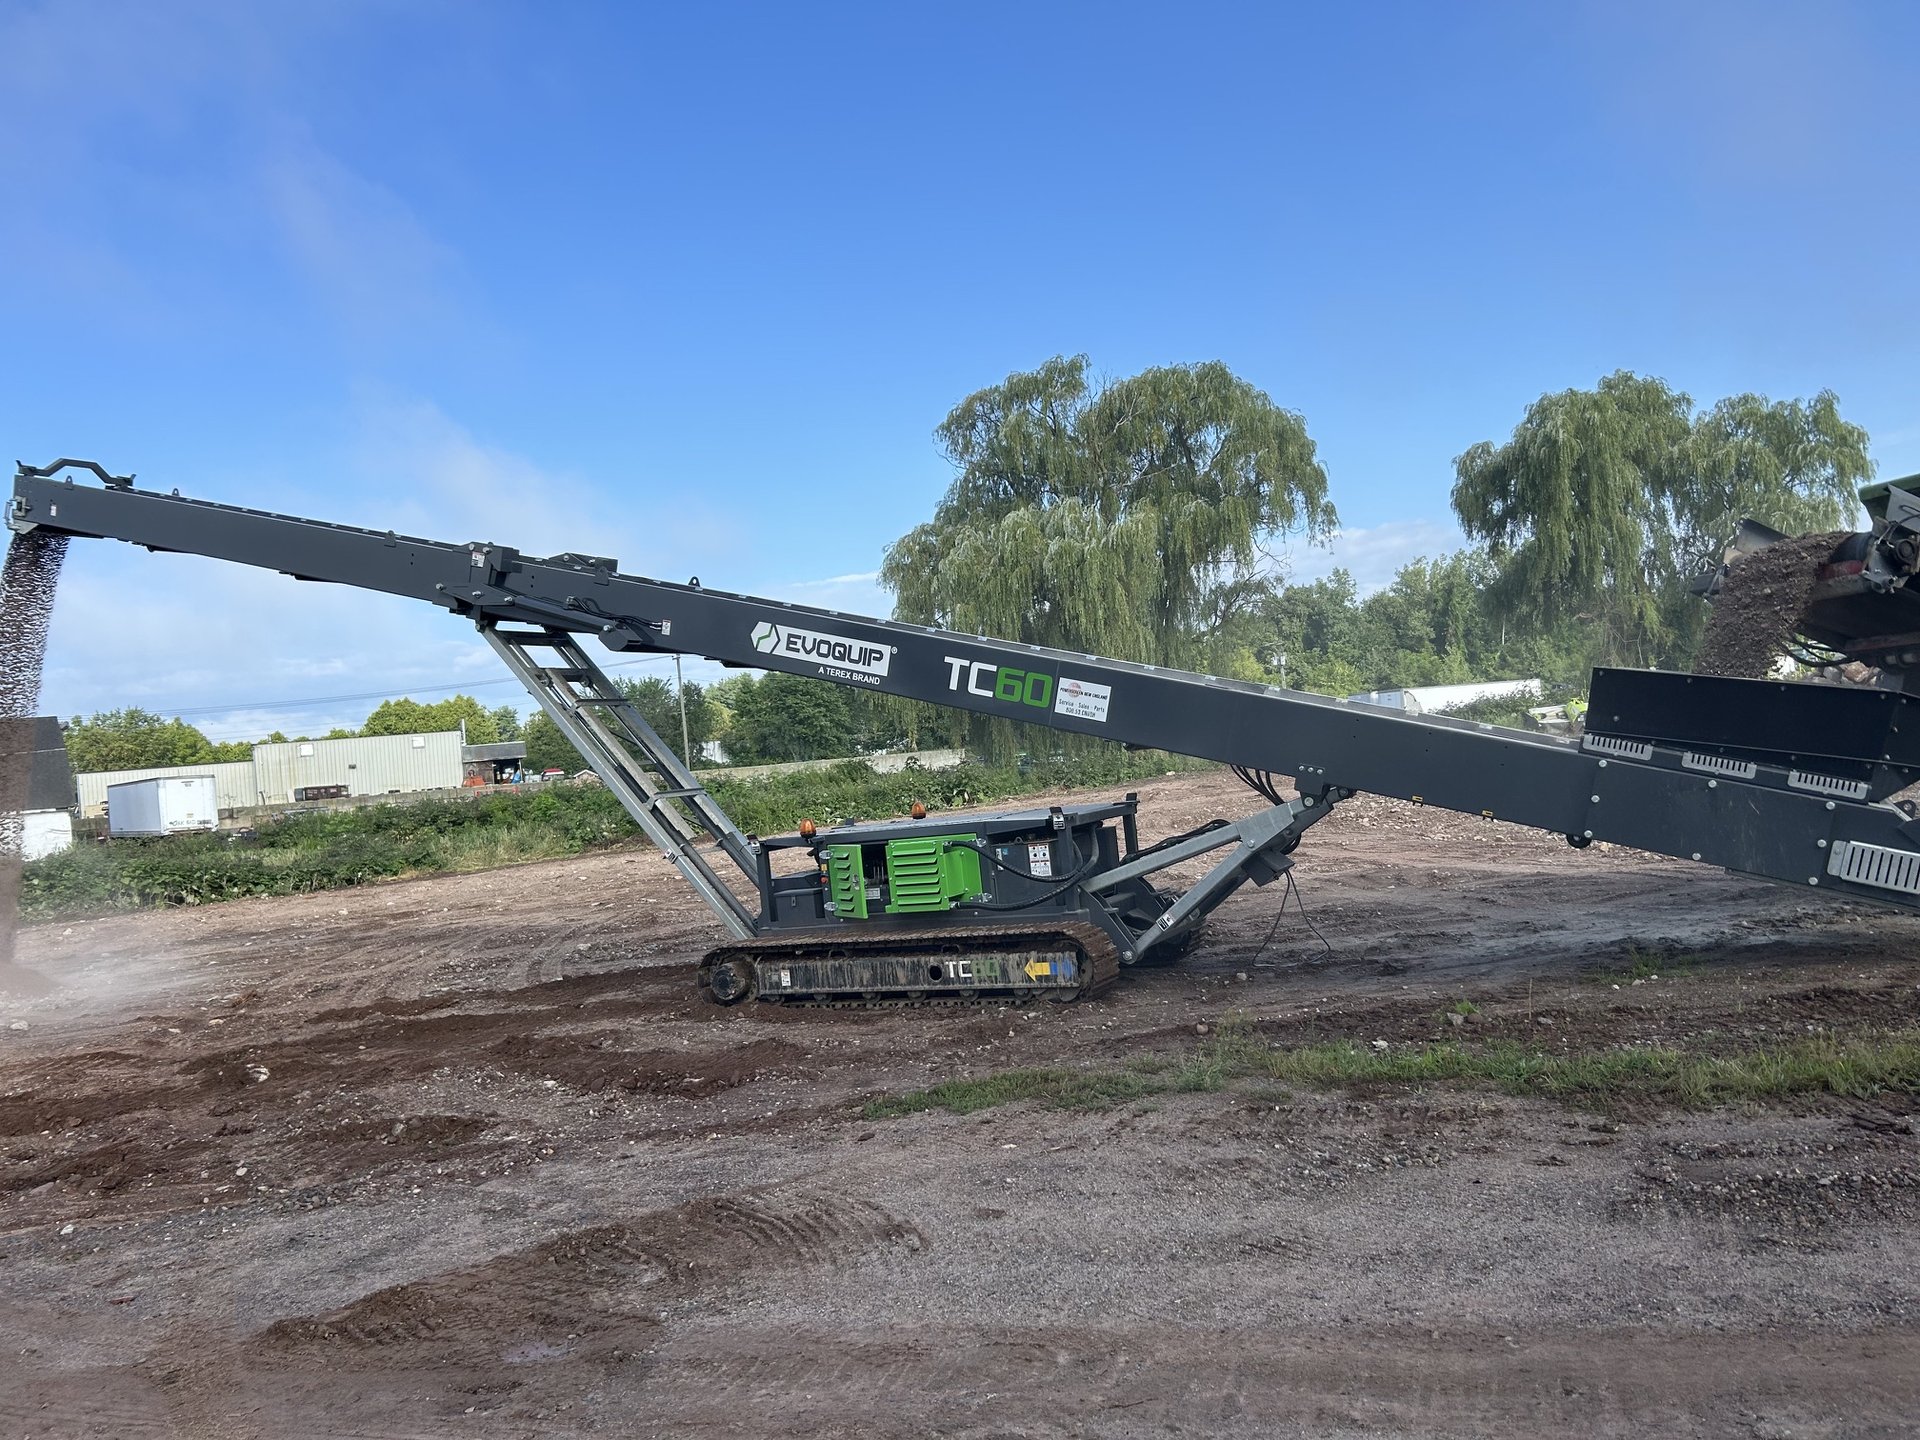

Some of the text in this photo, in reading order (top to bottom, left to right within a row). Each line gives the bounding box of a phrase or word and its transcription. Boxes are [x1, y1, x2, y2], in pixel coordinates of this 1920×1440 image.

[786, 633, 884, 667] EVOQUIP
[818, 666, 881, 685] A TEREX BRAND
[944, 656, 1053, 708] TC60
